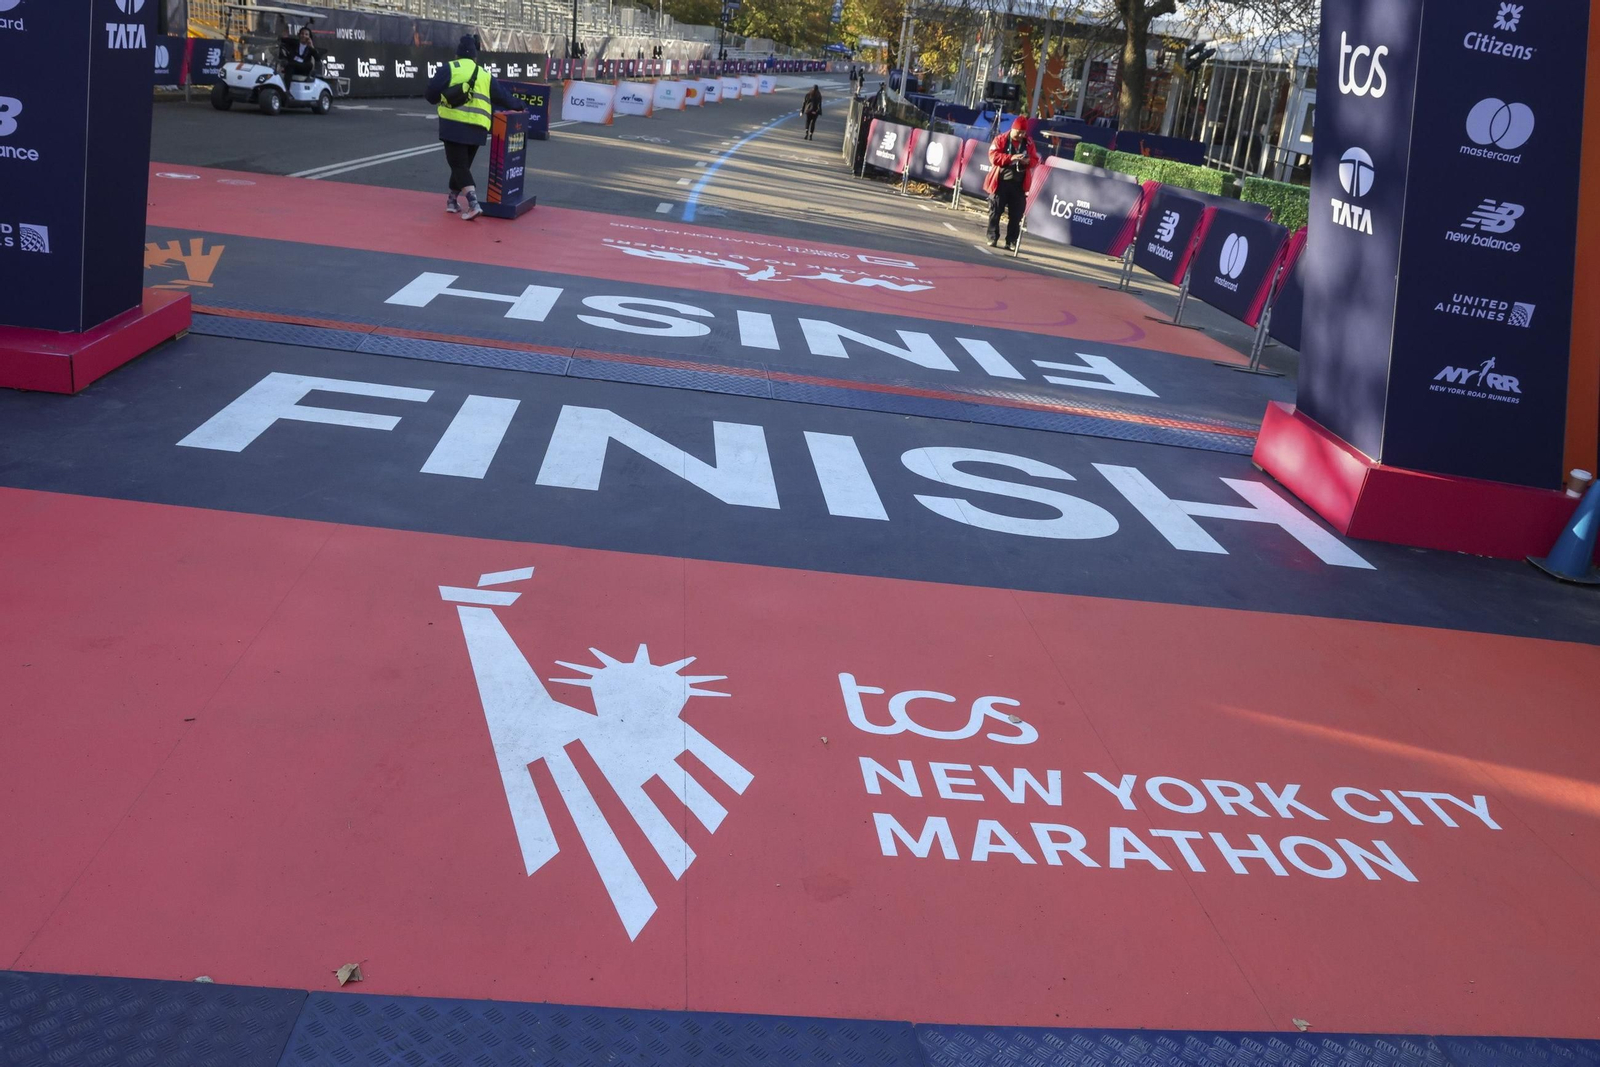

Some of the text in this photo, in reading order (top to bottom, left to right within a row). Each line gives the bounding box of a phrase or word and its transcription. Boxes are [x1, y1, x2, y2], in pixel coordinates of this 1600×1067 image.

[105, 22, 147, 49] TATA
[1463, 32, 1534, 61] Citizens
[357, 57, 370, 78] tcs
[1338, 31, 1389, 98] tcs
[570, 96, 585, 107] tcs
[1460, 145, 1521, 164] mastercard
[1050, 194, 1074, 220] tcs
[1074, 207, 1107, 221] CONSULTANCY
[1076, 199, 1090, 209] TATA
[1072, 214, 1093, 226] SERVICES
[1331, 198, 1373, 235] TATA
[1147, 242, 1174, 261] new balance
[1445, 230, 1521, 252] new balance
[602, 237, 934, 285] NEW YORK ROAD RUNNERS
[1214, 276, 1239, 292] mastercard
[1434, 302, 1505, 322] AIRLINES
[1452, 293, 1509, 311] UNITED
[384, 271, 1160, 398] FINISH
[1429, 384, 1520, 404] NEW YORK ROAD RUNNERS
[175, 371, 1377, 570] FINISH
[838, 672, 1039, 745] tcs
[858, 756, 1503, 830] NEW YORK CITY
[872, 812, 1419, 882] MARATHON
